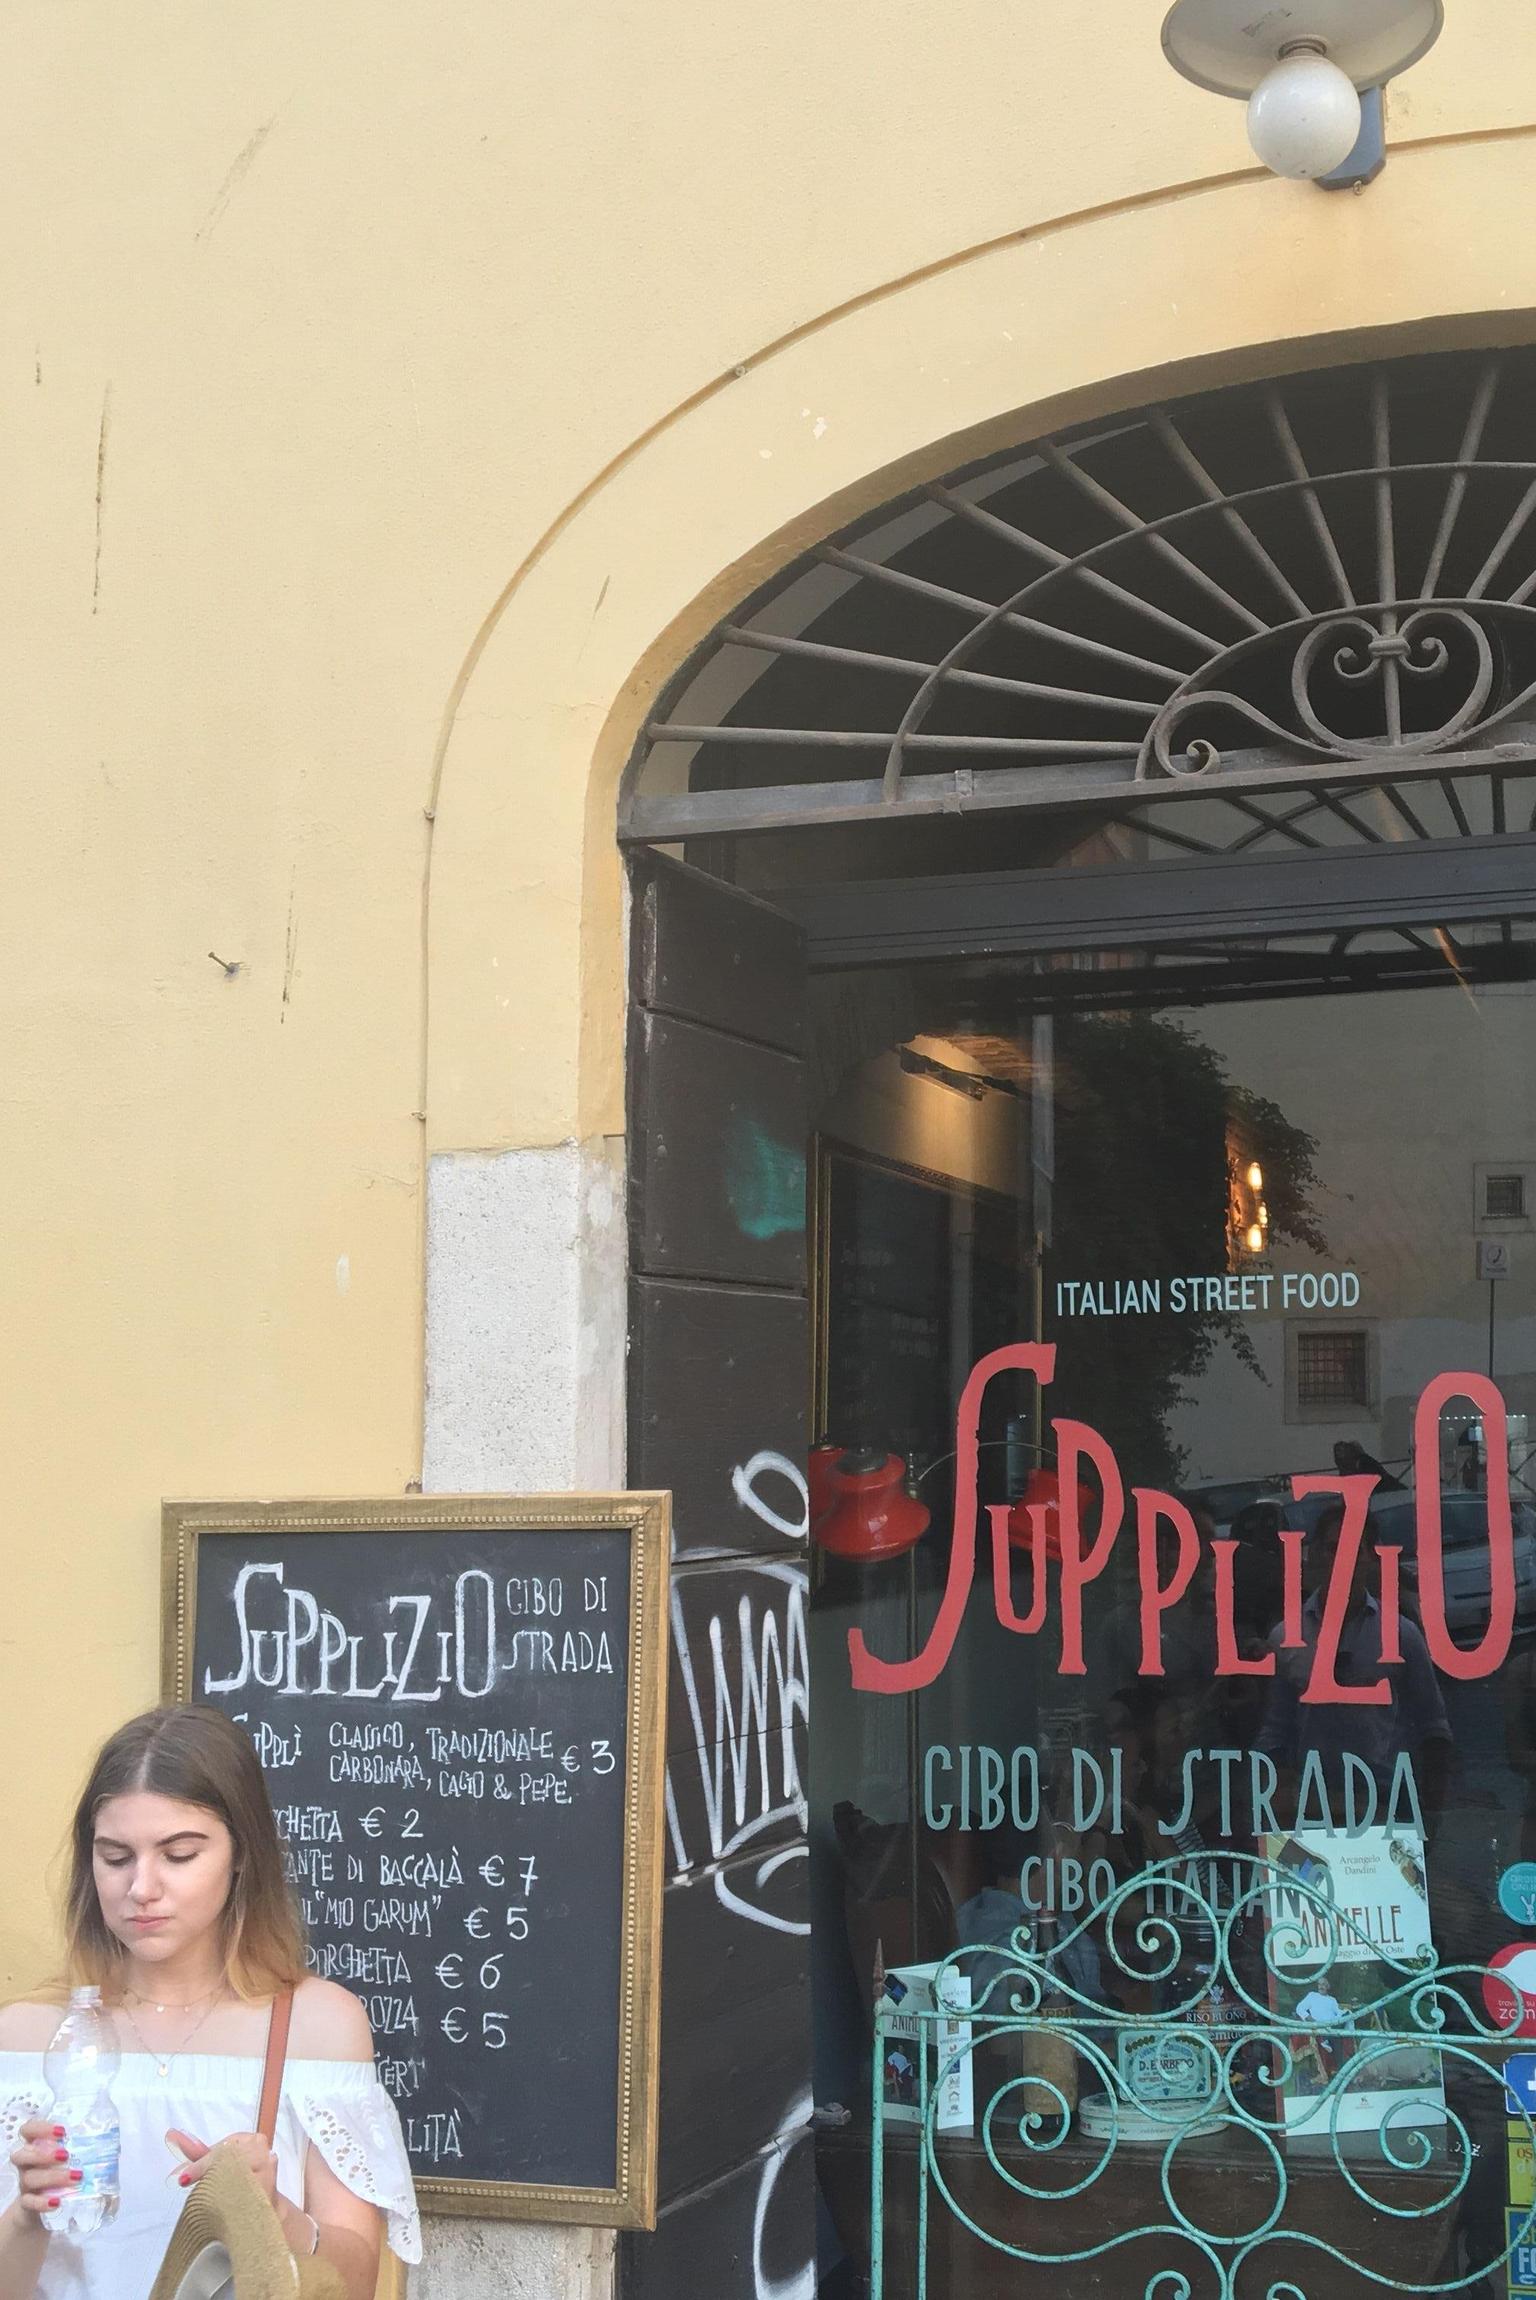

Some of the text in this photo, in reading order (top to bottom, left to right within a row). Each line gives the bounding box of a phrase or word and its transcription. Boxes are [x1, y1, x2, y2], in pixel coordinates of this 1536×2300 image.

[1056, 1272, 1361, 1316] ITALIAN STREET FOOD
[848, 1341, 1516, 1704] SUPPLIZIO
[506, 1577, 608, 1617] CIBO DI
[502, 1630, 613, 1674] STRADA
[426, 1727, 554, 1764] TRADIZIONALE
[560, 1746, 581, 1772] €
[591, 1740, 616, 1774] 3
[330, 1751, 432, 1791] CARBONARA,
[494, 1774, 512, 1799] &
[519, 1773, 572, 1804] PEPE
[924, 1745, 1427, 1841] CIBO DI STRADA
[274, 1806, 424, 1842] CHETTA € 2
[281, 1846, 538, 1895] ANTE DI BACCALÀ € 7
[1020, 1855, 1336, 1919] CIBO ITALIANO
[463, 1907, 491, 1939] €
[506, 1907, 529, 1939] 5
[304, 1943, 504, 1989] PORCHETTA € 6
[440, 2007, 469, 2043] €
[483, 2012, 510, 2048] 5
